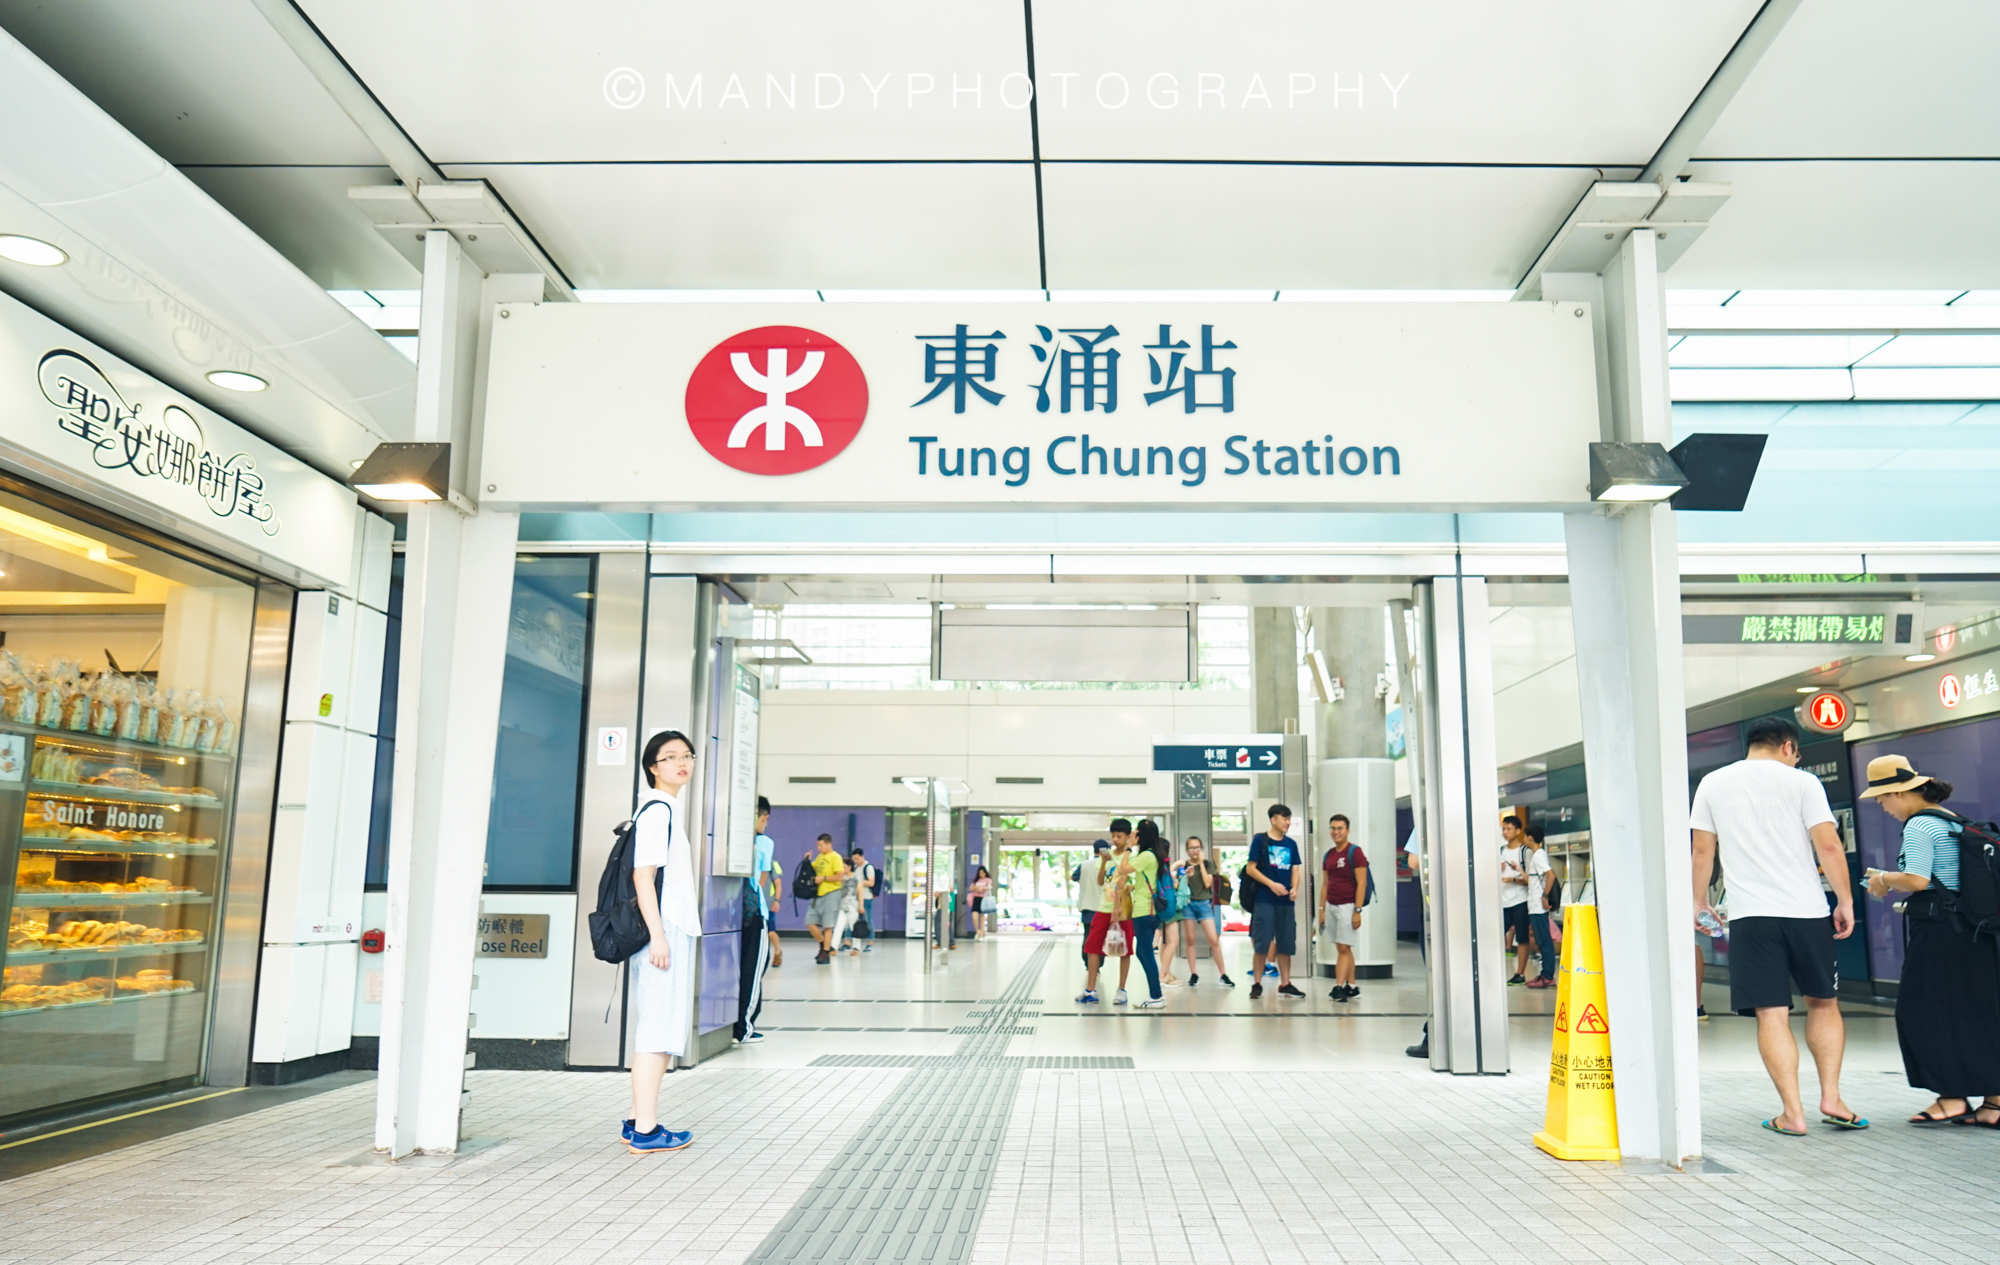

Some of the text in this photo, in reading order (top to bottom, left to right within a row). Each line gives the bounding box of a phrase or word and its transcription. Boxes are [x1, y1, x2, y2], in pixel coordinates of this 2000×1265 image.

[910, 323, 1237, 415] 東涌站
[38, 348, 281, 537] 聖安娜餅屋
[908, 434, 1401, 487] Tung Chung Station
[1204, 748, 1228, 761] 車票
[43, 800, 164, 830] Saint Honore
[478, 918, 525, 935] 防喉轆
[481, 939, 543, 953] ose Reel
[1575, 1082, 1590, 1090] WET
